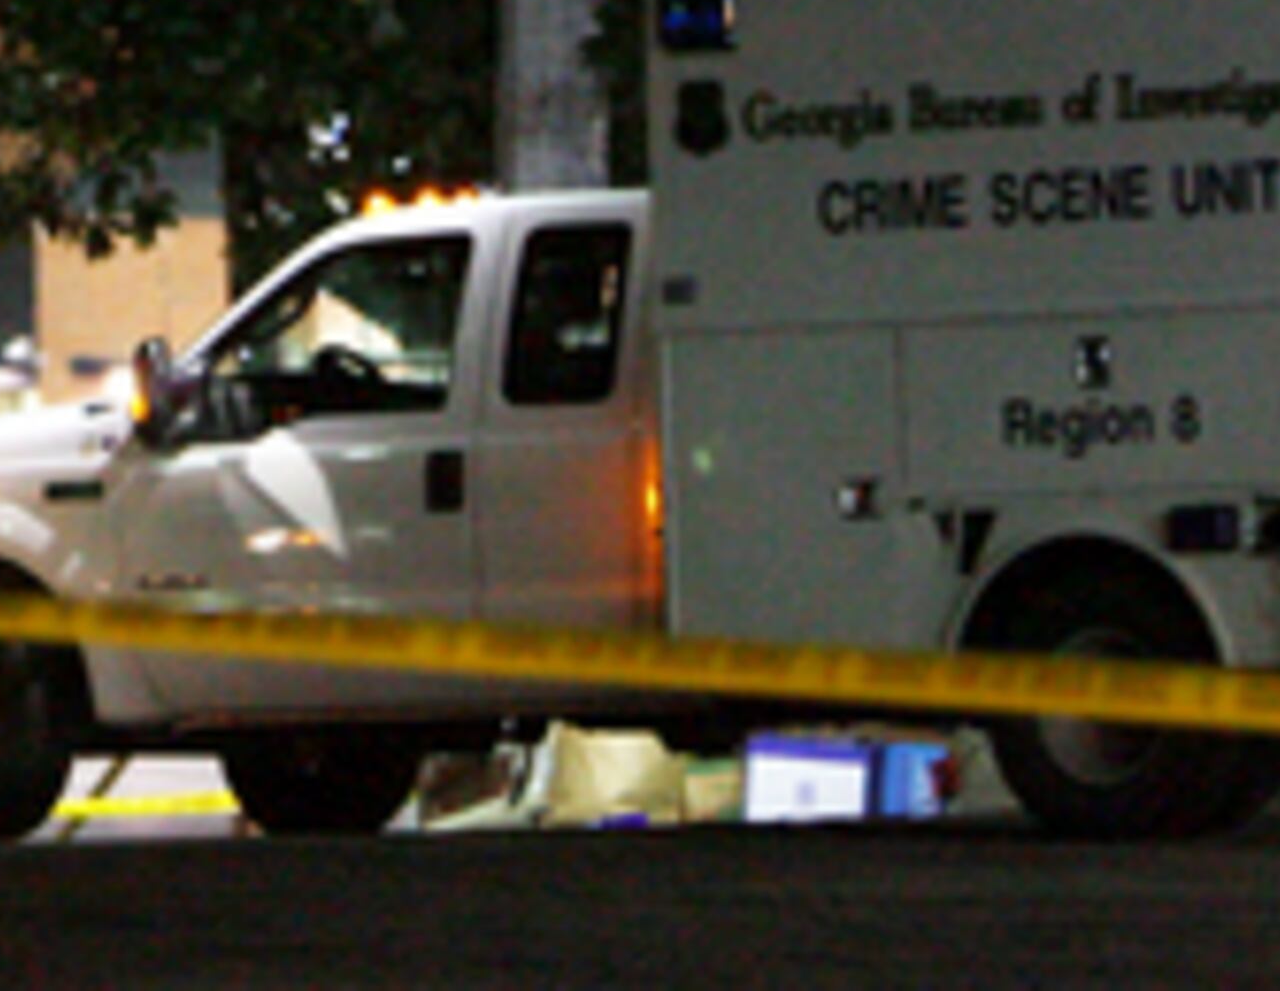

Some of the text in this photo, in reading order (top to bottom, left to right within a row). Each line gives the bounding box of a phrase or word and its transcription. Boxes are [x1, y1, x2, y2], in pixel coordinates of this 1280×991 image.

[742, 87, 894, 150] Georgia
[909, 79, 1043, 132] Bureau
[1061, 71, 1102, 123] of
[817, 172, 970, 236] CRIME
[988, 167, 1152, 229] SCENE
[1002, 394, 1203, 459] Region 8
